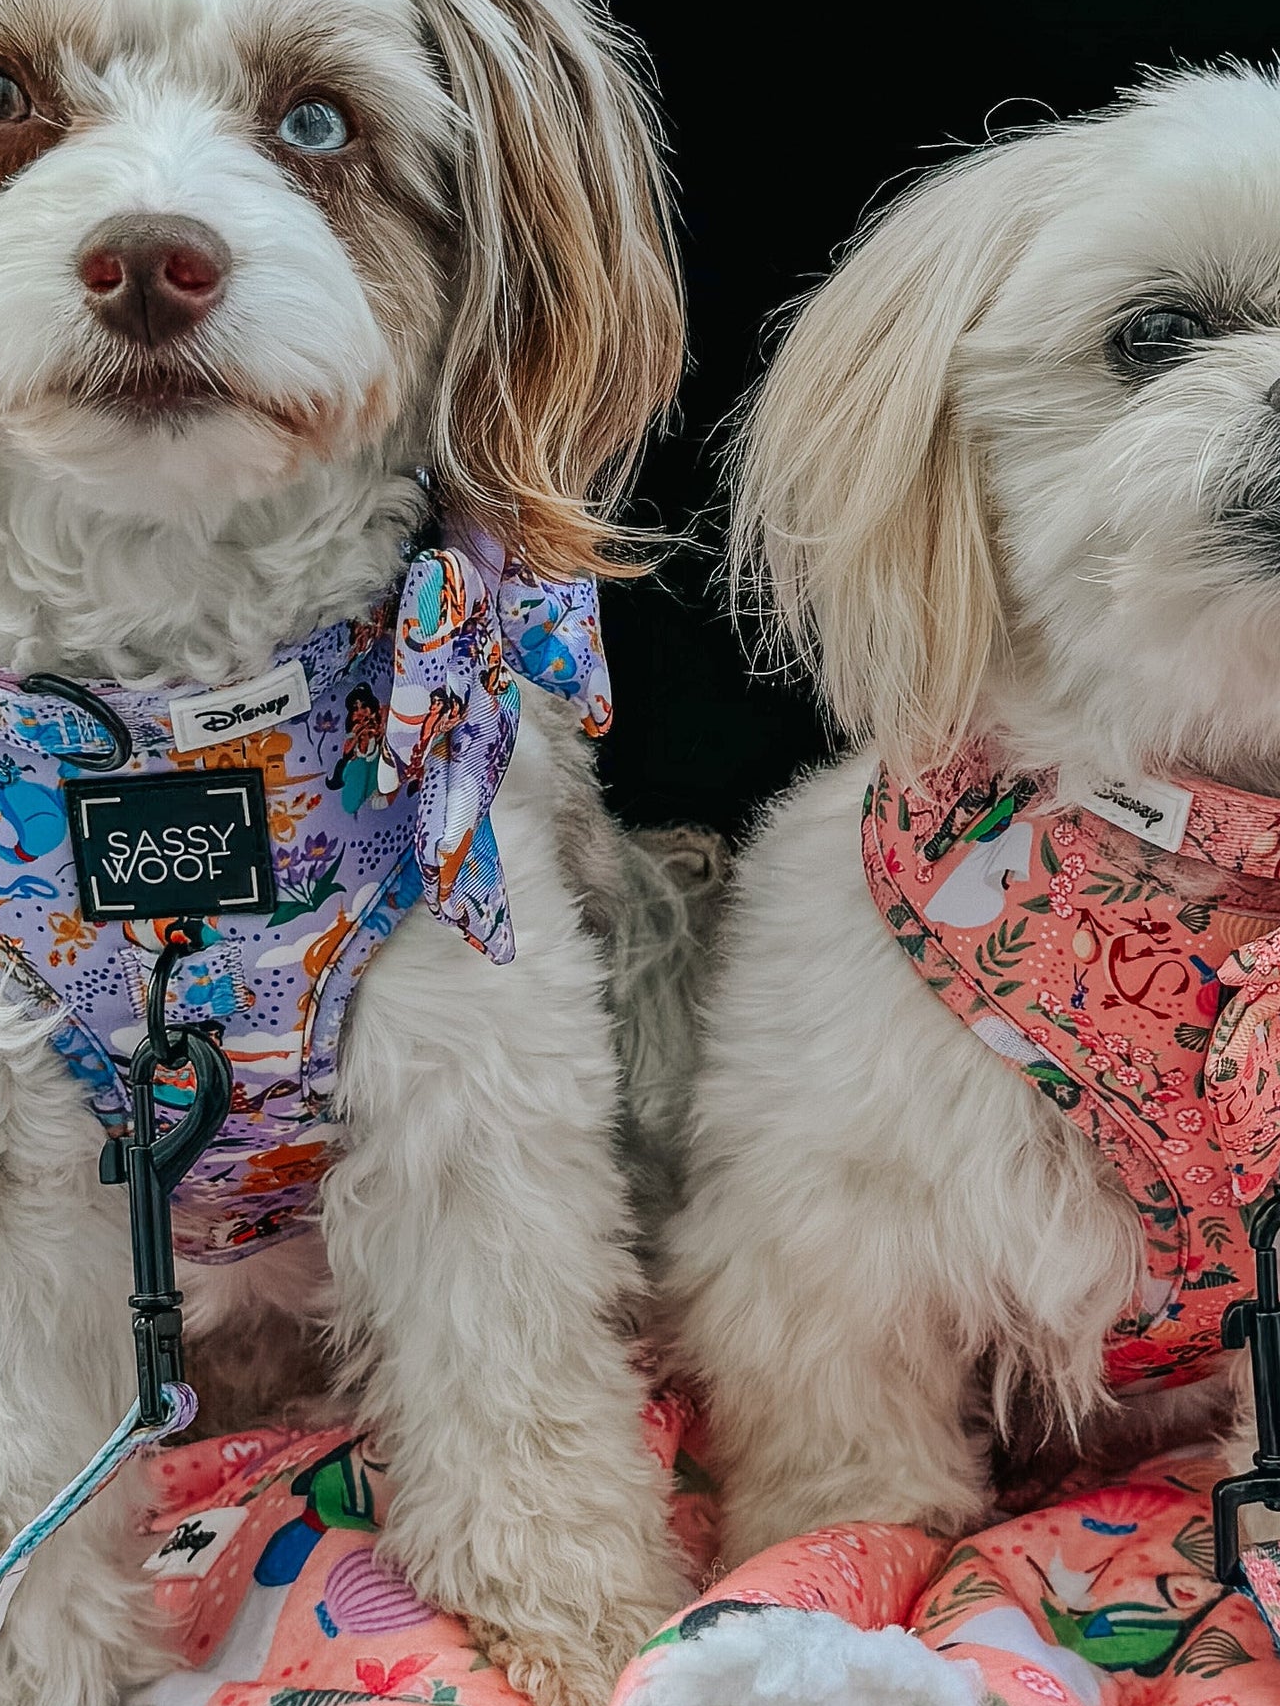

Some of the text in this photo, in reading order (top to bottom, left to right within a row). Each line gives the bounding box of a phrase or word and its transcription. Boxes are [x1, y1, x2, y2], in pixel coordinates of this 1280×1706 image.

[194, 694, 289, 732] Disney
[107, 822, 236, 860] SASSY
[101, 851, 231, 884] WOOF
